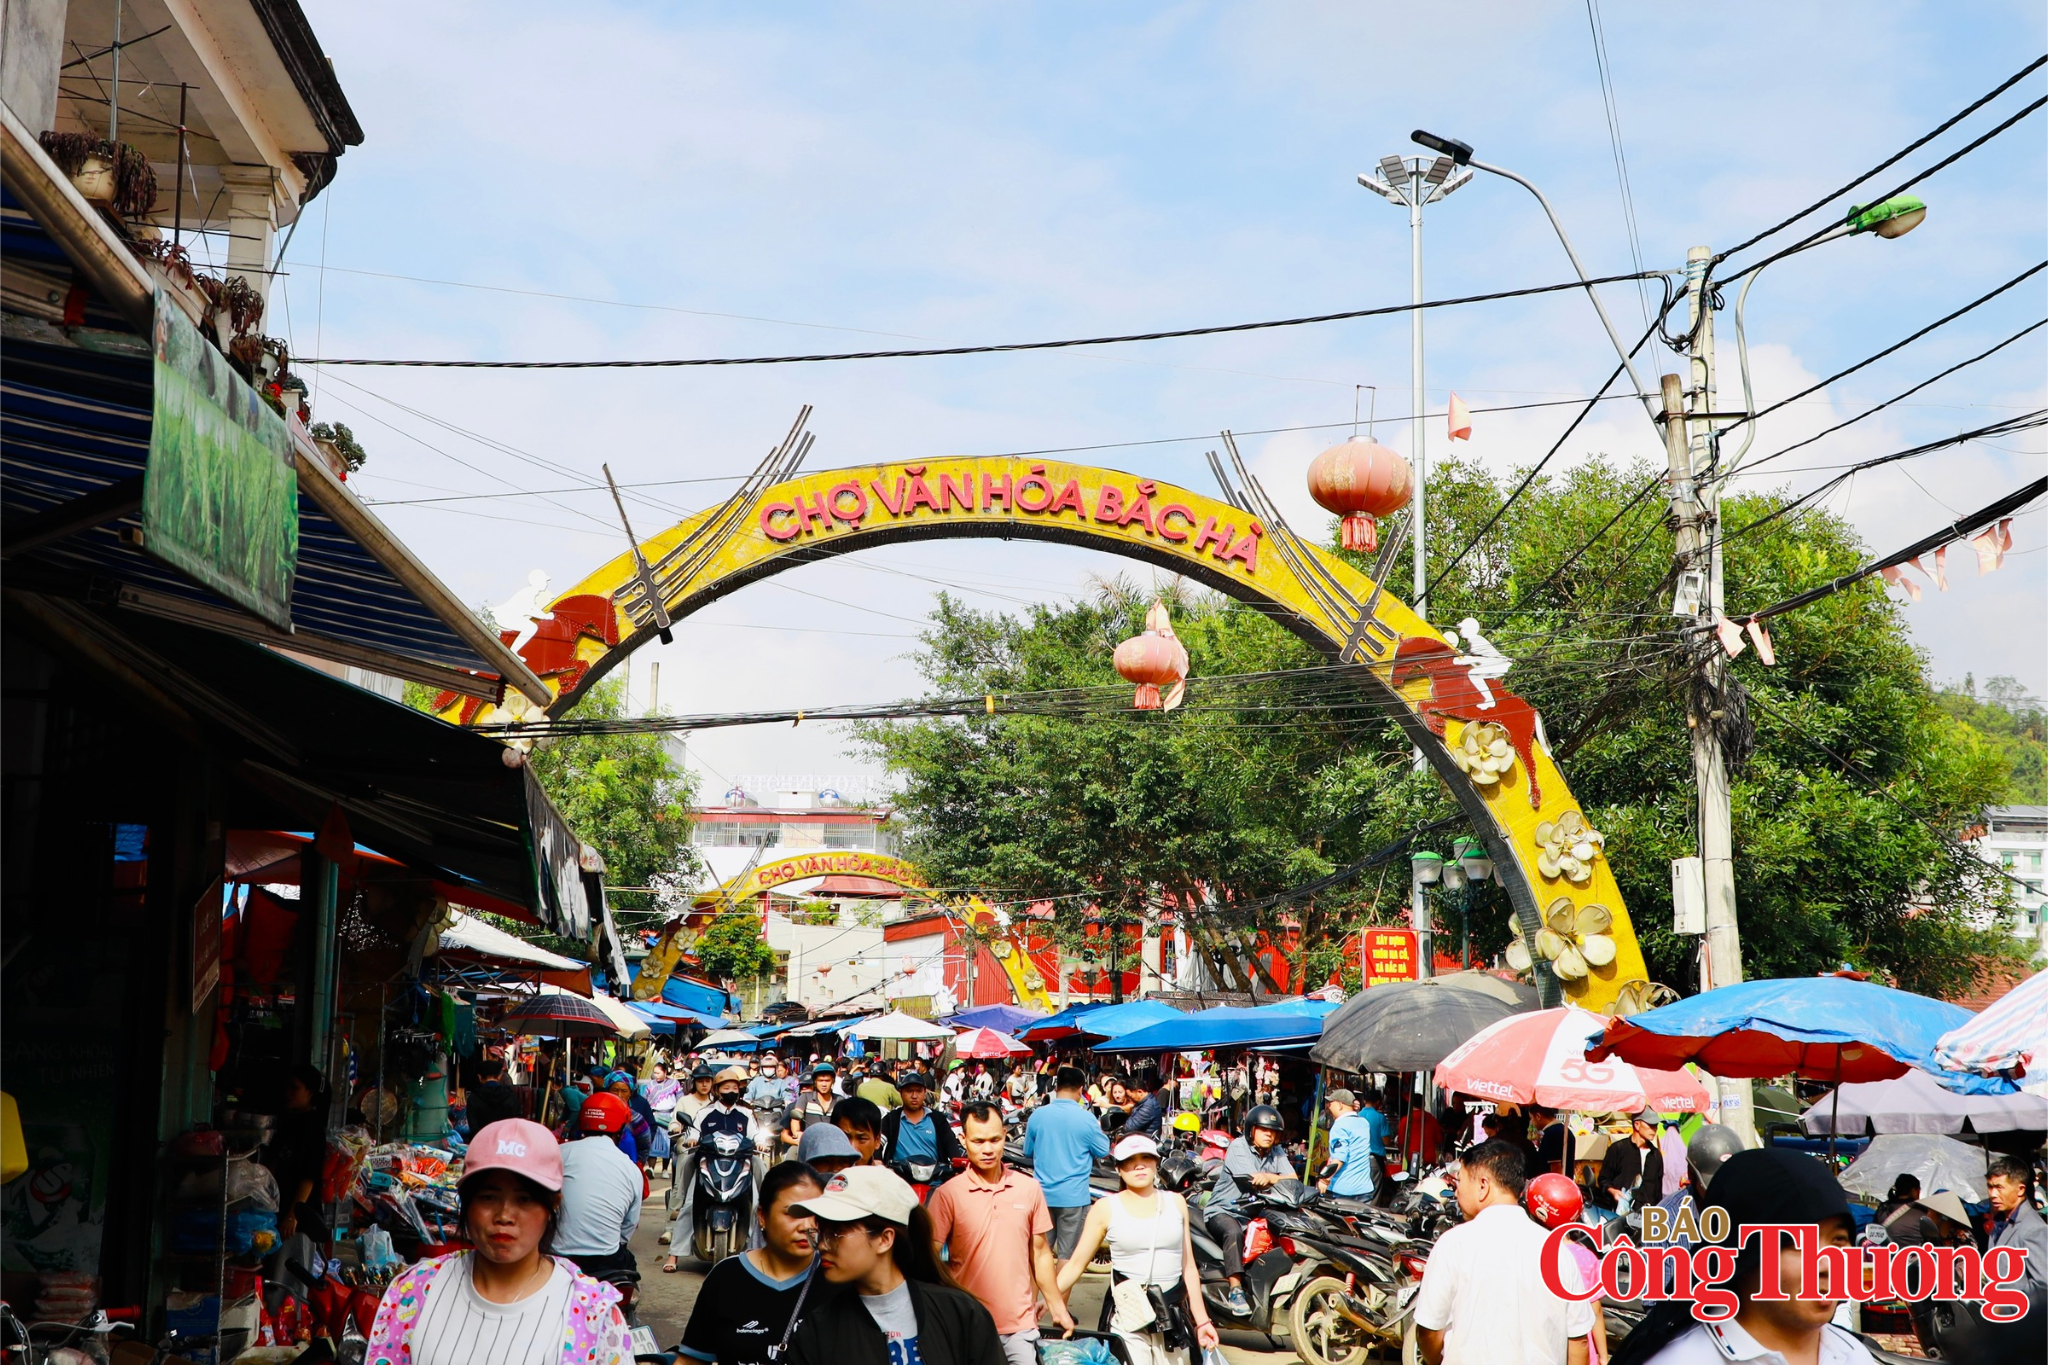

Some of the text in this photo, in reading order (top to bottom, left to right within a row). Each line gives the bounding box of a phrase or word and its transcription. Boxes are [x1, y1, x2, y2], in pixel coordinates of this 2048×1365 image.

[760, 463, 1264, 574] CHỢ VĂN HÓA BẮC HÀ
[758, 863, 796, 886] CHỢ
[800, 857, 834, 874] VĂN
[836, 854, 874, 873] HÓA
[1560, 1058, 1615, 1084] 5G
[1466, 1077, 1514, 1098] viettel
[1661, 1096, 1695, 1109] viettel
